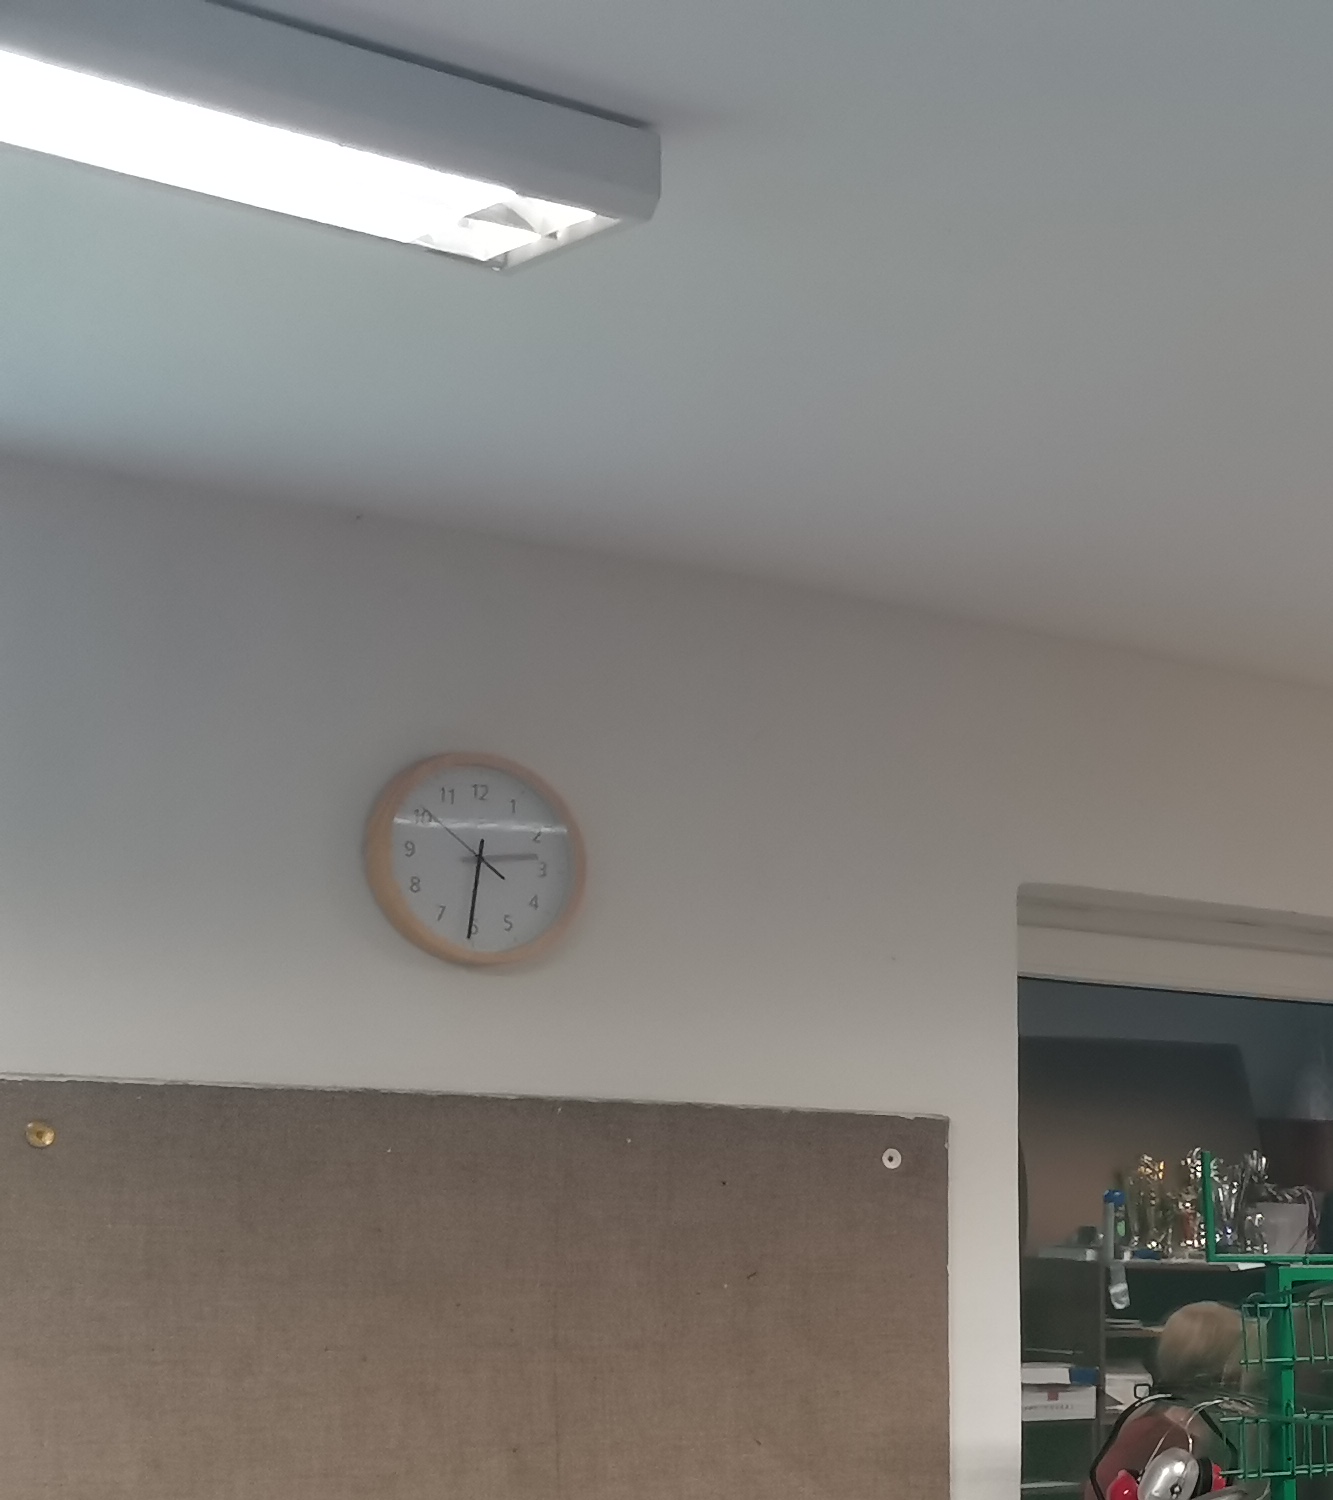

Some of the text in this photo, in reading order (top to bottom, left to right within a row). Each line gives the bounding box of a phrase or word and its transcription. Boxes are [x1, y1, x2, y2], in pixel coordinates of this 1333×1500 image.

[440, 787, 456, 805] 11
[472, 784, 490, 801] 12
[404, 840, 416, 857] 9
[537, 861, 548, 878] 3
[409, 876, 421, 893] 8
[528, 894, 539, 910] 4
[436, 905, 447, 921] 7
[503, 914, 514, 932] 5
